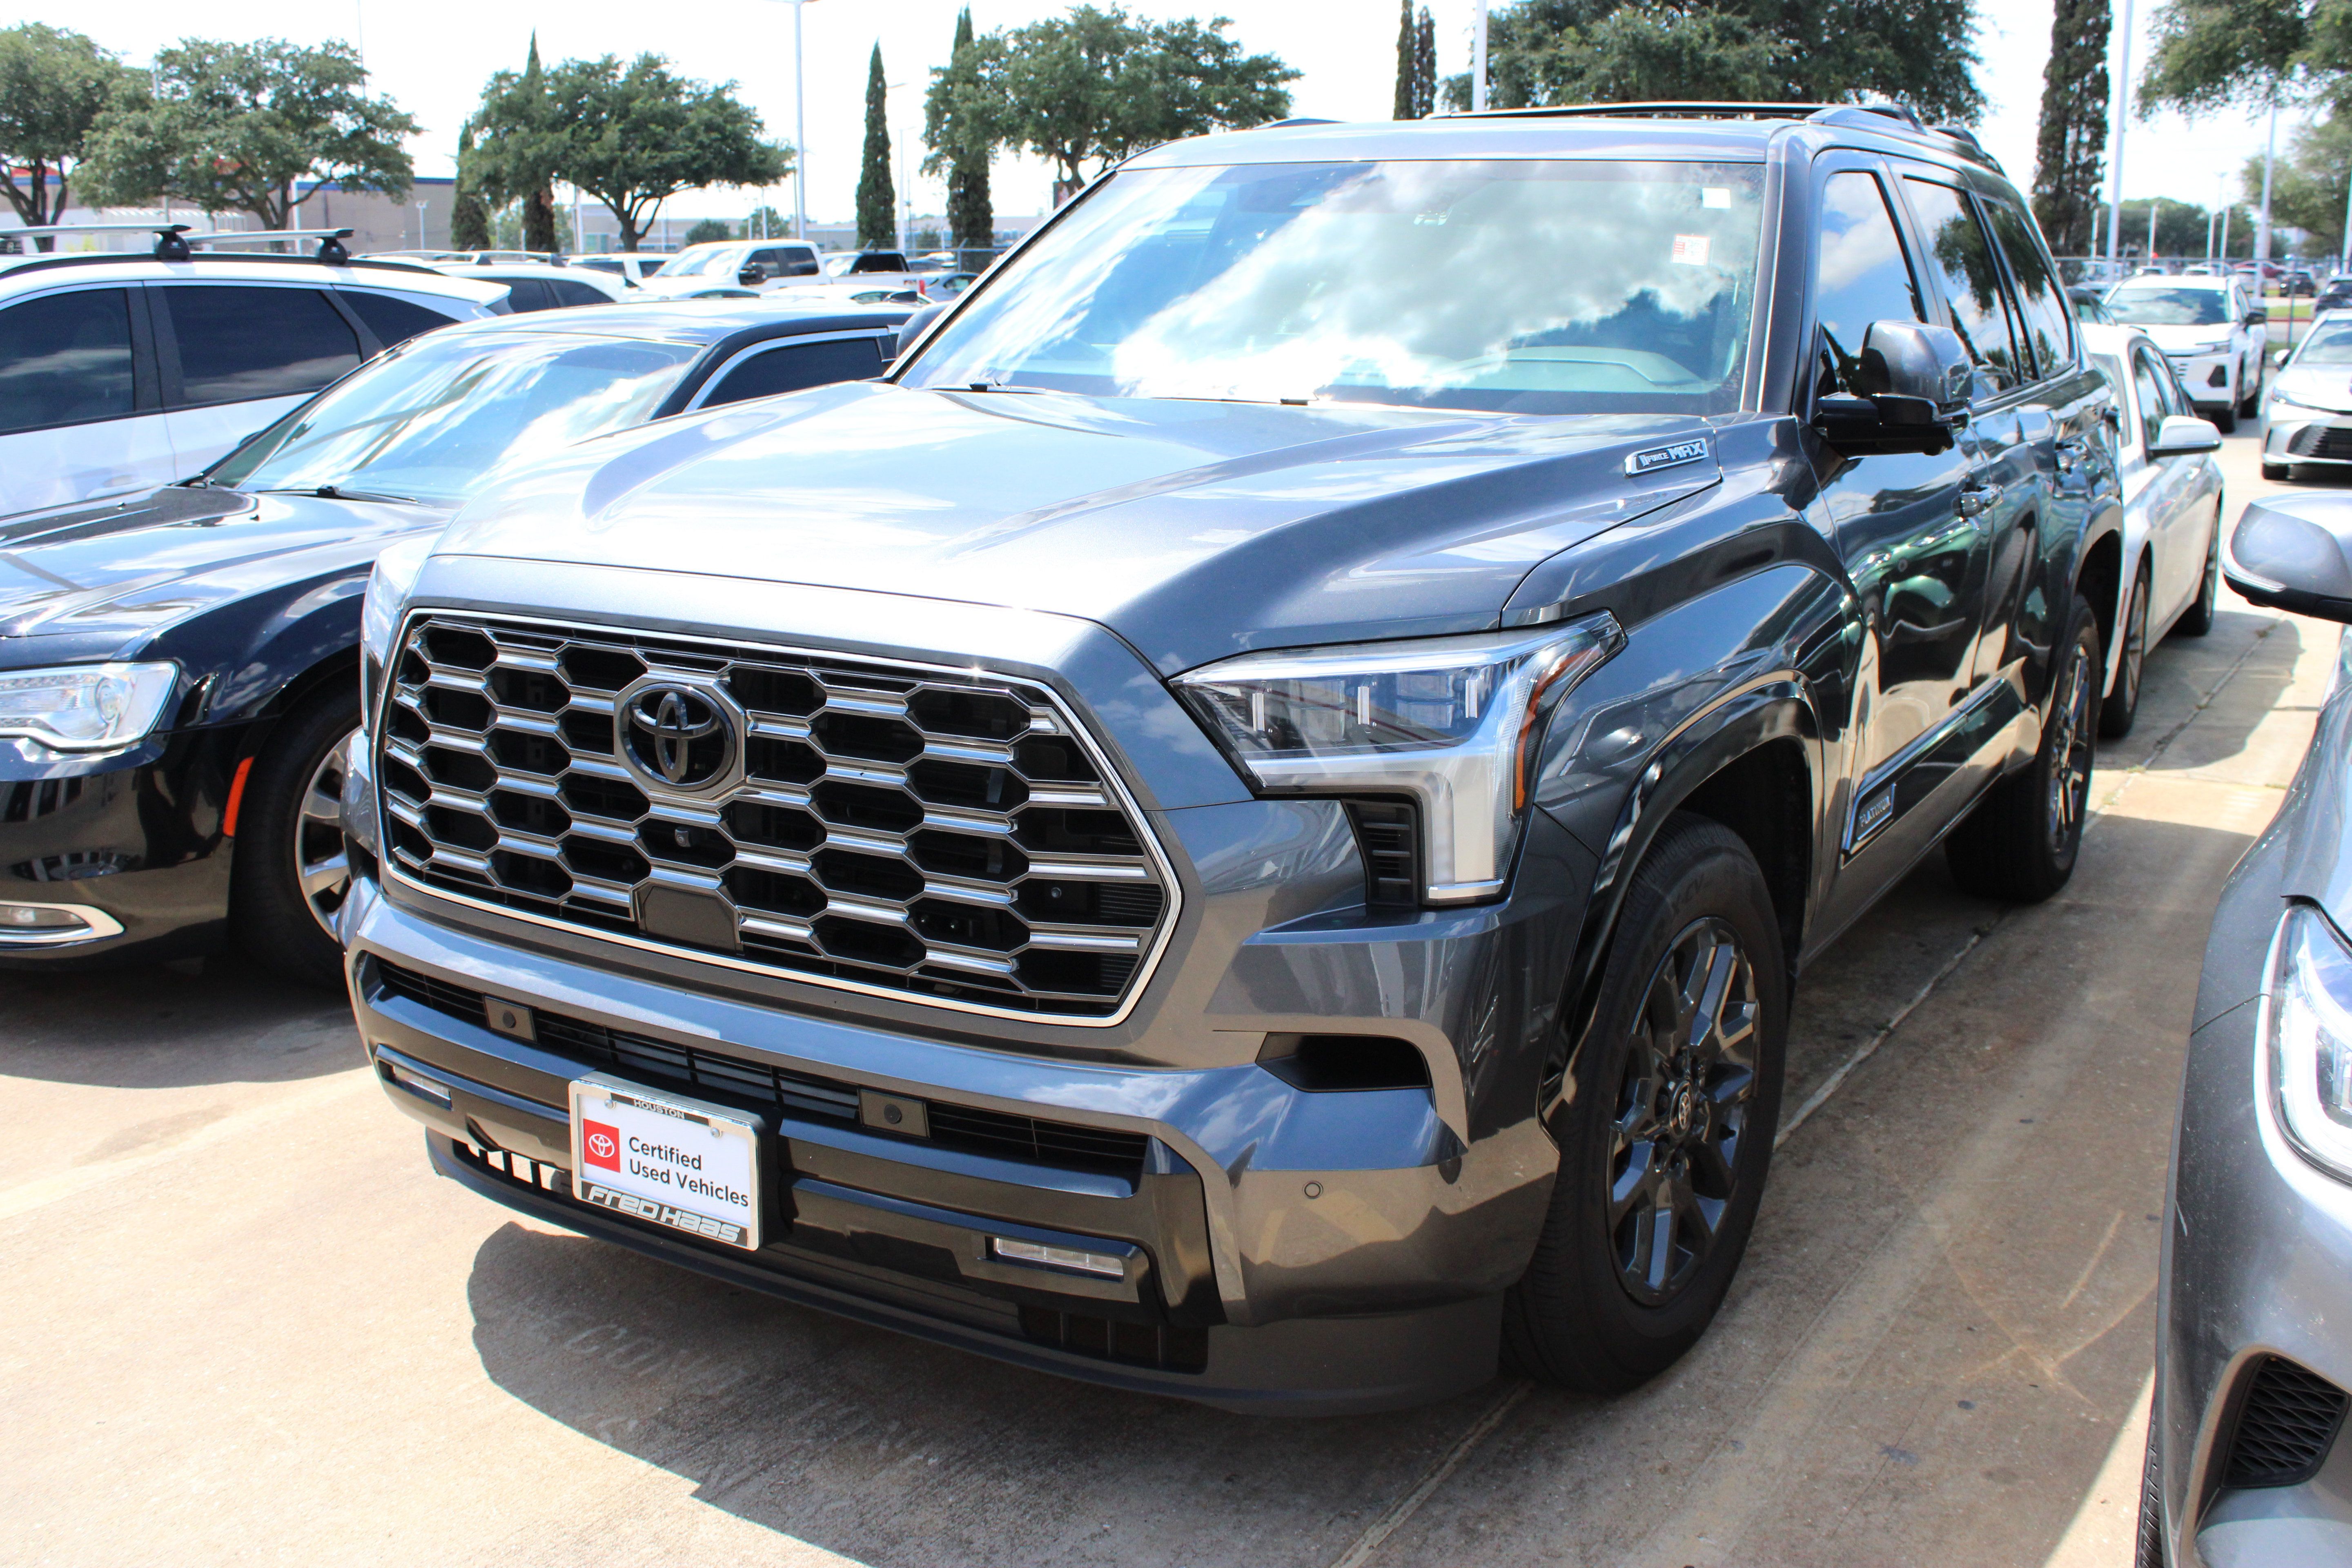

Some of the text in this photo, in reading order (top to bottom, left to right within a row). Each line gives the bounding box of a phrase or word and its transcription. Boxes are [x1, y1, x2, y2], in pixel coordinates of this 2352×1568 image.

[1666, 442, 1704, 461] MAX
[634, 1100, 685, 1119] HOUSTON
[629, 1136, 702, 1171] Certified
[630, 1158, 749, 1207] Used Vehicles
